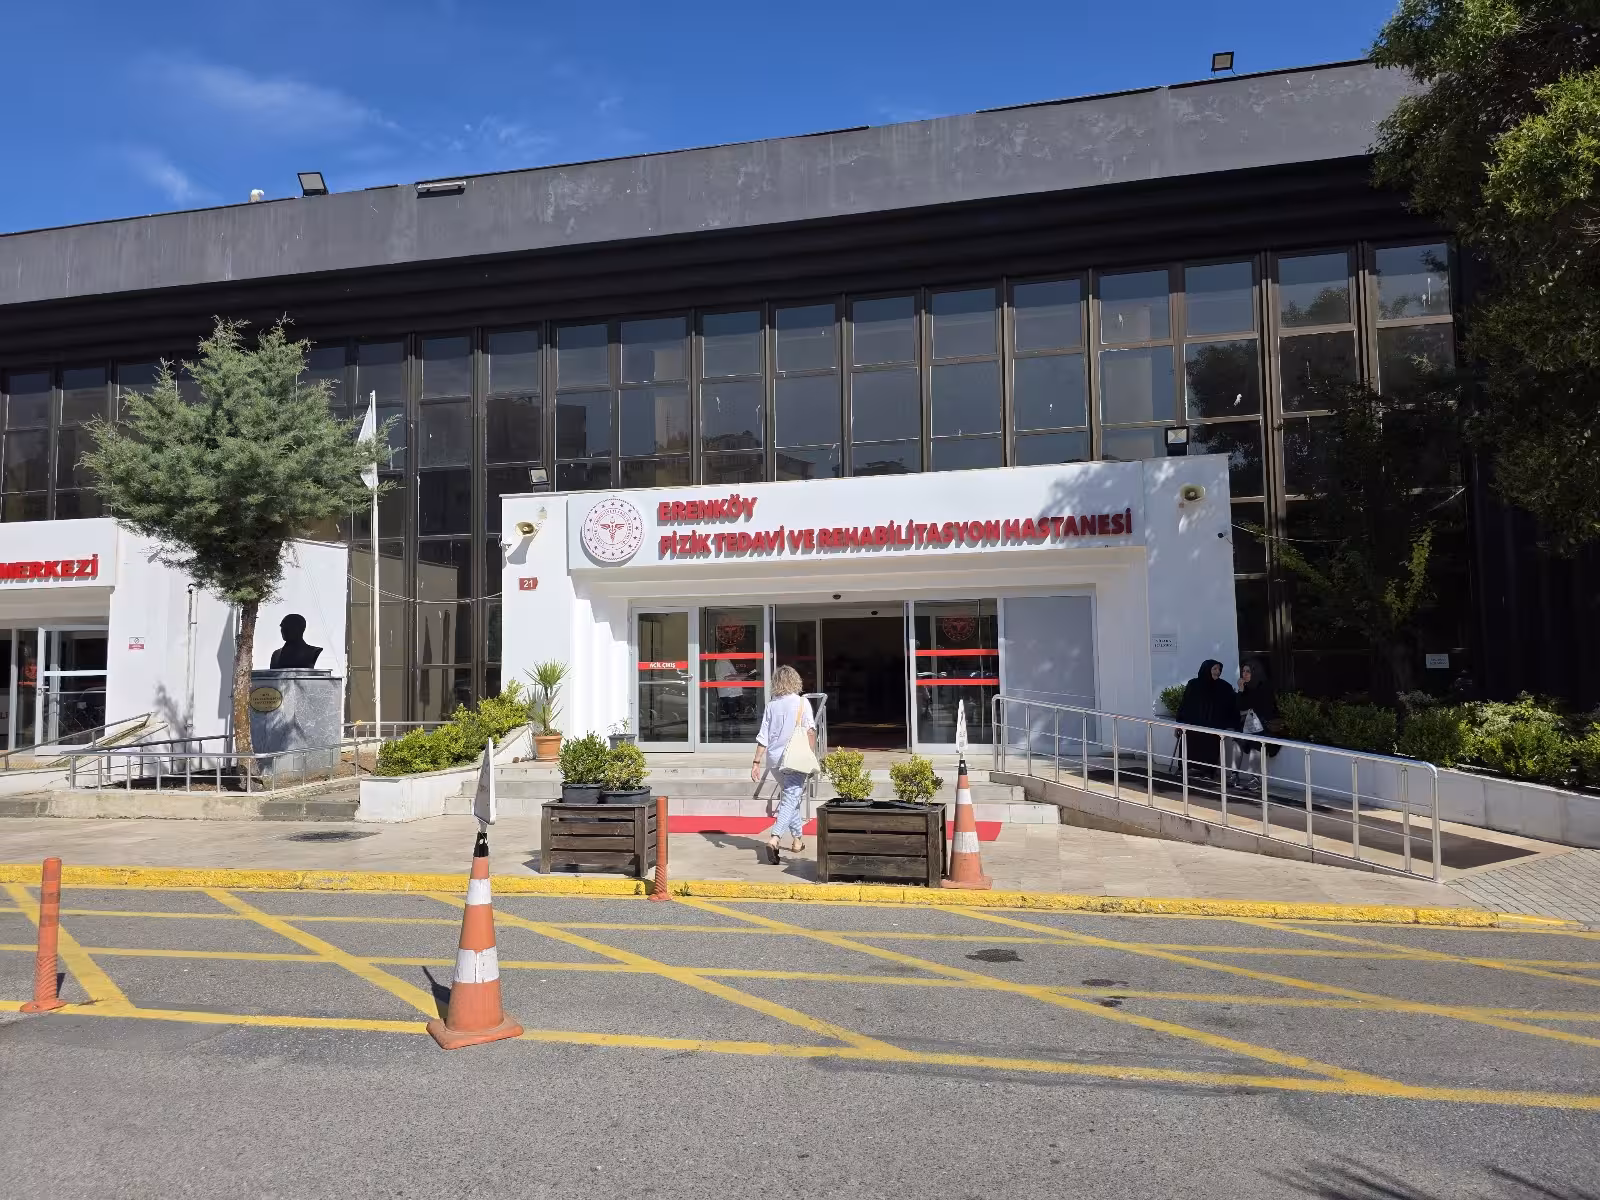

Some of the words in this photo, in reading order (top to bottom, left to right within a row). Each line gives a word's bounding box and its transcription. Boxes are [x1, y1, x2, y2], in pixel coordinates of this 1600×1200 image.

[658, 494, 758, 521] ERENKÖY
[660, 530, 712, 555] FİZİK
[714, 525, 785, 552] TEDAVİ
[788, 528, 815, 549] VE
[818, 519, 1001, 548] REHABİLİTASYON
[1004, 507, 1132, 537] HASTANESİ
[0, 554, 98, 579] MERKEZİ
[523, 579, 533, 588] 21
